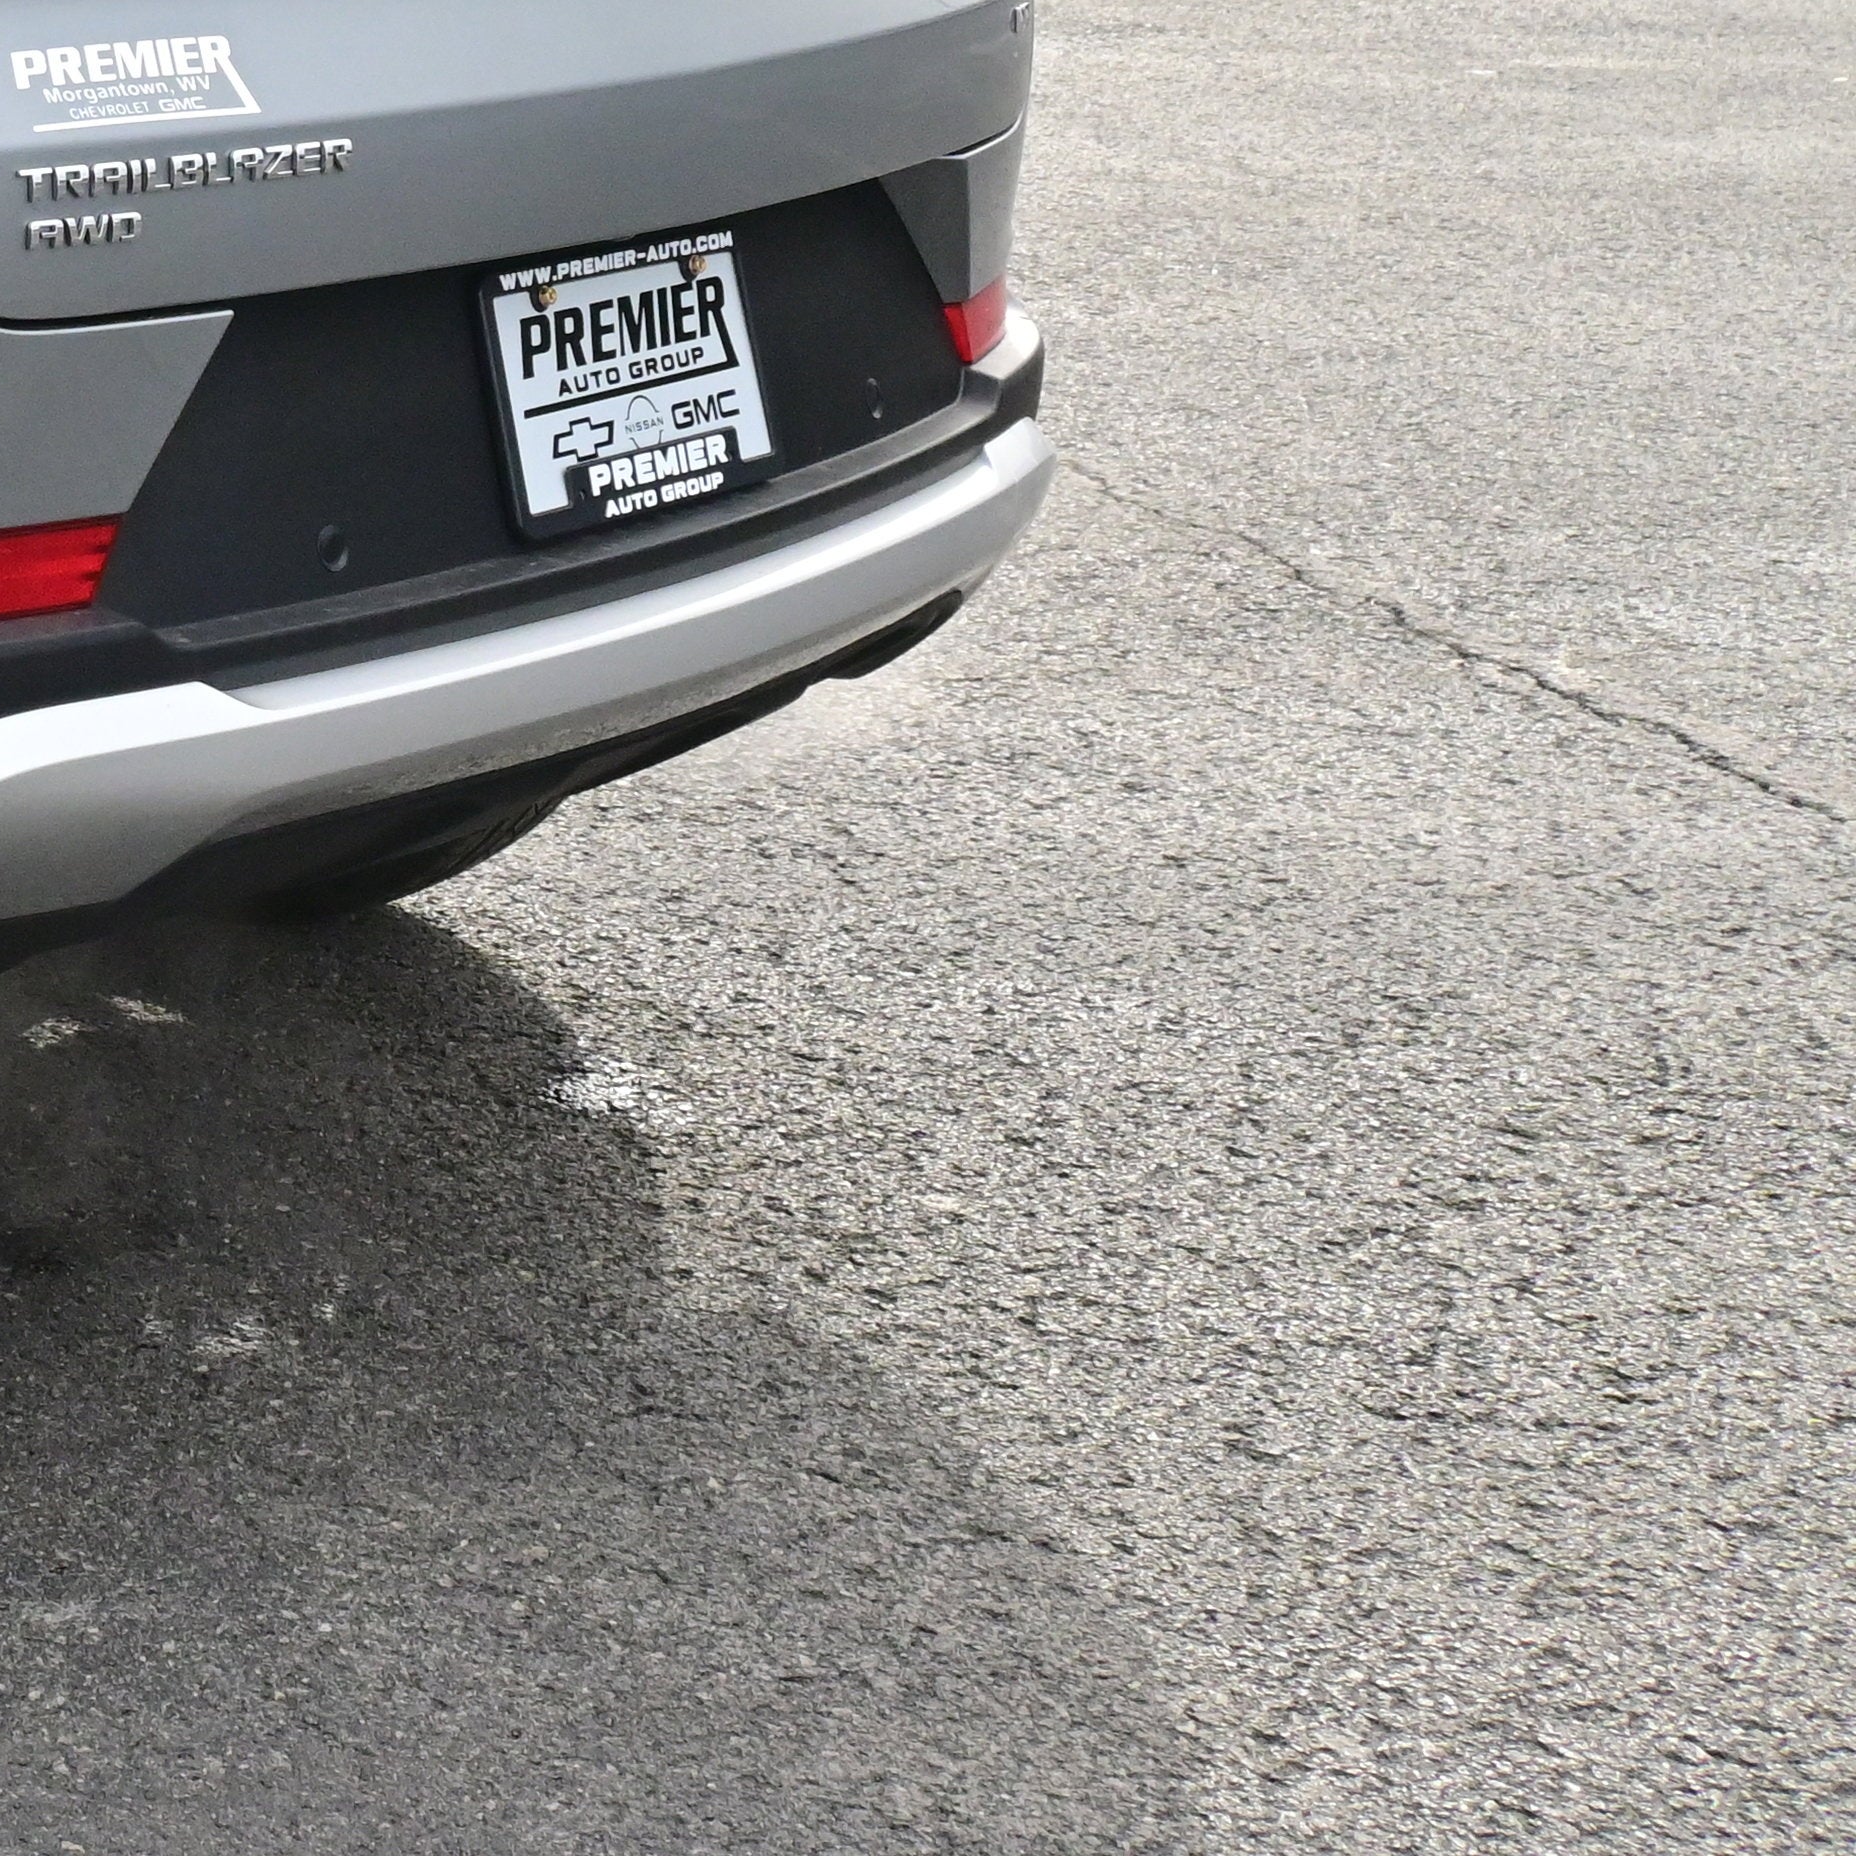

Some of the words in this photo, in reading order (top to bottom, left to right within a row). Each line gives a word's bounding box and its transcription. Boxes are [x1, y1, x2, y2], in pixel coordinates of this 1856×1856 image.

[10, 35, 231, 90] PREMIER
[42, 81, 176, 105] Morgantown,
[176, 75, 211, 93] WV
[68, 101, 150, 121] CHEVROLET
[157, 96, 207, 113] GMC
[15, 138, 353, 202] TRAILBLAZER
[25, 211, 142, 250] AWD
[499, 230, 734, 291] WWW.PREMIER-AUTO.COM
[519, 275, 726, 380] PREMIER
[558, 366, 621, 397] AUTO
[628, 346, 705, 379] GROUP
[624, 416, 665, 435] NISSAN
[671, 389, 741, 430] GMC
[588, 433, 729, 497] PREMIER
[604, 489, 659, 518] AUTO
[660, 471, 725, 504] GROUP
